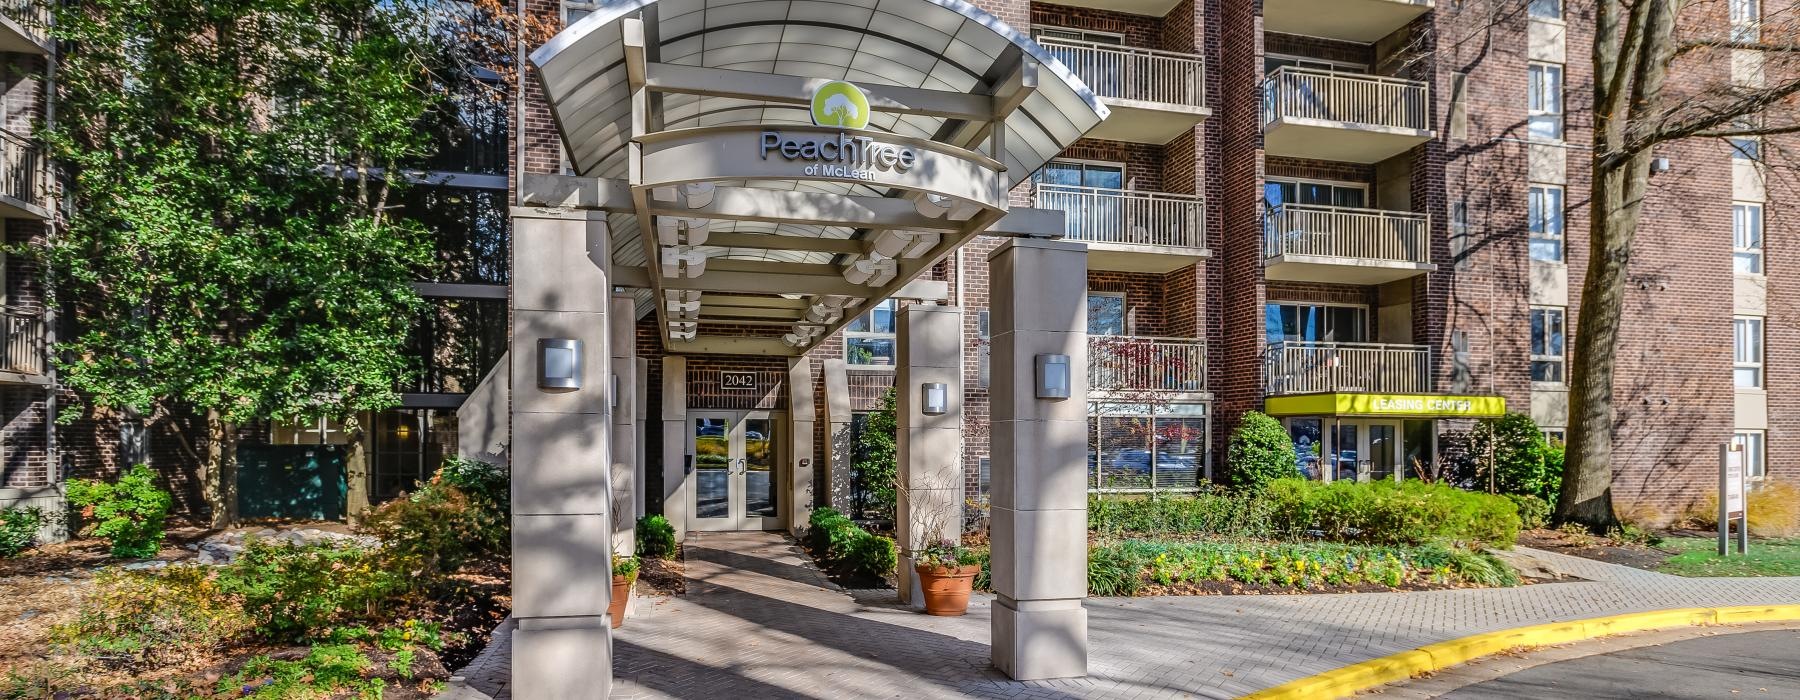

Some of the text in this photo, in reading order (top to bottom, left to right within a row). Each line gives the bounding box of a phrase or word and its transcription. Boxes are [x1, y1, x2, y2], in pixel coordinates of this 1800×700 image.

[760, 131, 915, 170] PeachTree
[804, 164, 876, 181] of McLean
[725, 375, 753, 386] 2042
[1373, 399, 1471, 411] LEASING CENTER
